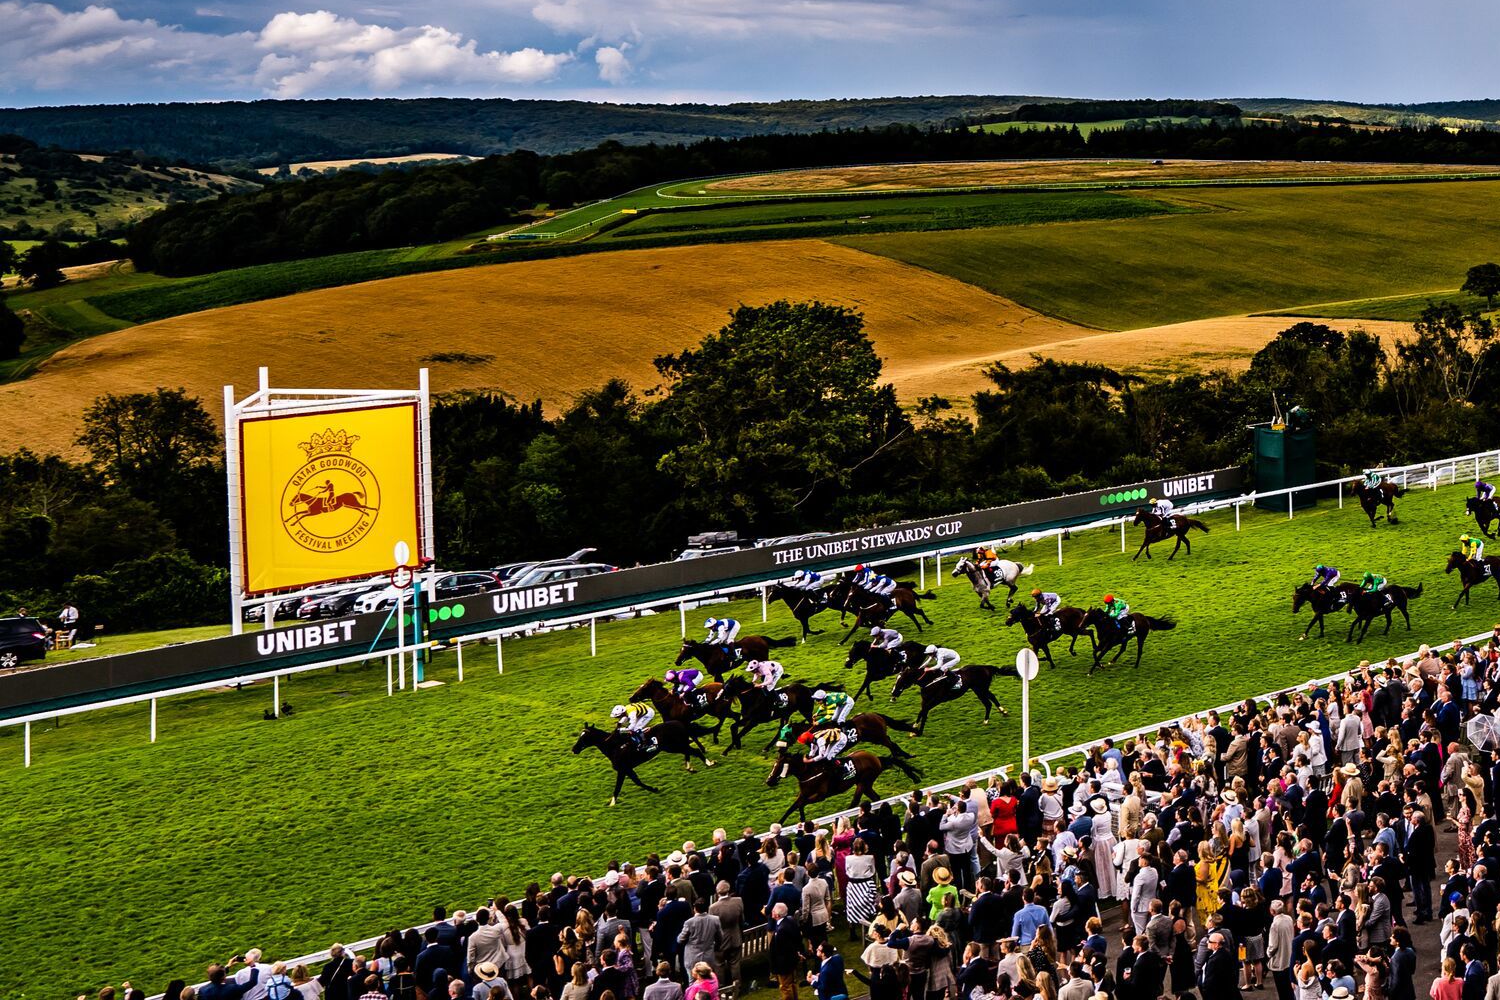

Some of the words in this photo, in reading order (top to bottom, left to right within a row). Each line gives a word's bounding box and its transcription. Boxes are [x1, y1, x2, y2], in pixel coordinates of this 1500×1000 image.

[292, 464, 317, 487] QATAR
[319, 458, 367, 478] GOODWOOD
[1163, 475, 1216, 497] UNIBET
[295, 529, 332, 549] FESTIVAL
[335, 520, 370, 548] MEETING
[773, 544, 803, 566] THE
[805, 536, 860, 561] UNIBET
[861, 525, 934, 554] STEWARDS'
[935, 520, 963, 539] CUP
[492, 581, 579, 614] UNIBET
[256, 619, 356, 656] UNIBET
